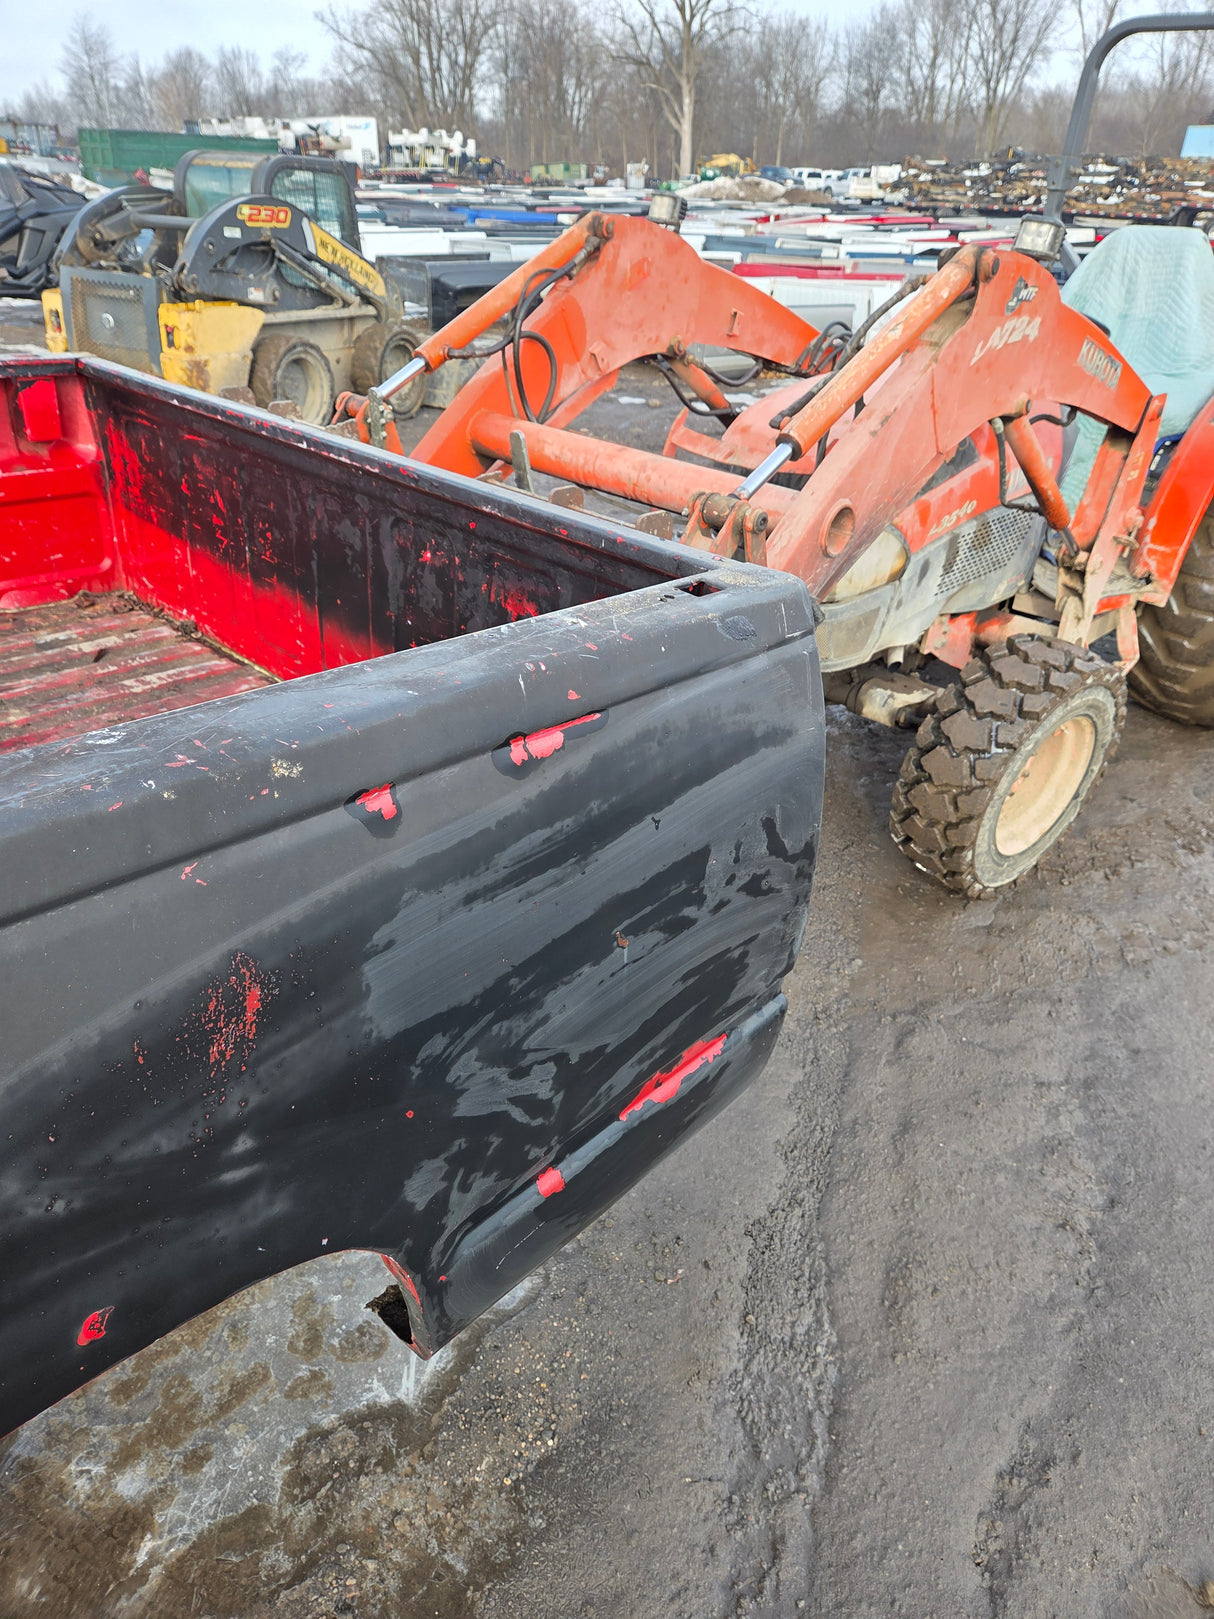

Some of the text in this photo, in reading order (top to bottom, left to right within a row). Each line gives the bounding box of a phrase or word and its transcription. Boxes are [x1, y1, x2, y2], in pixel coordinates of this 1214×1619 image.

[969, 315, 1042, 366] LA724
[1077, 336, 1123, 391] KUBOTA
[927, 499, 977, 538] L3540
